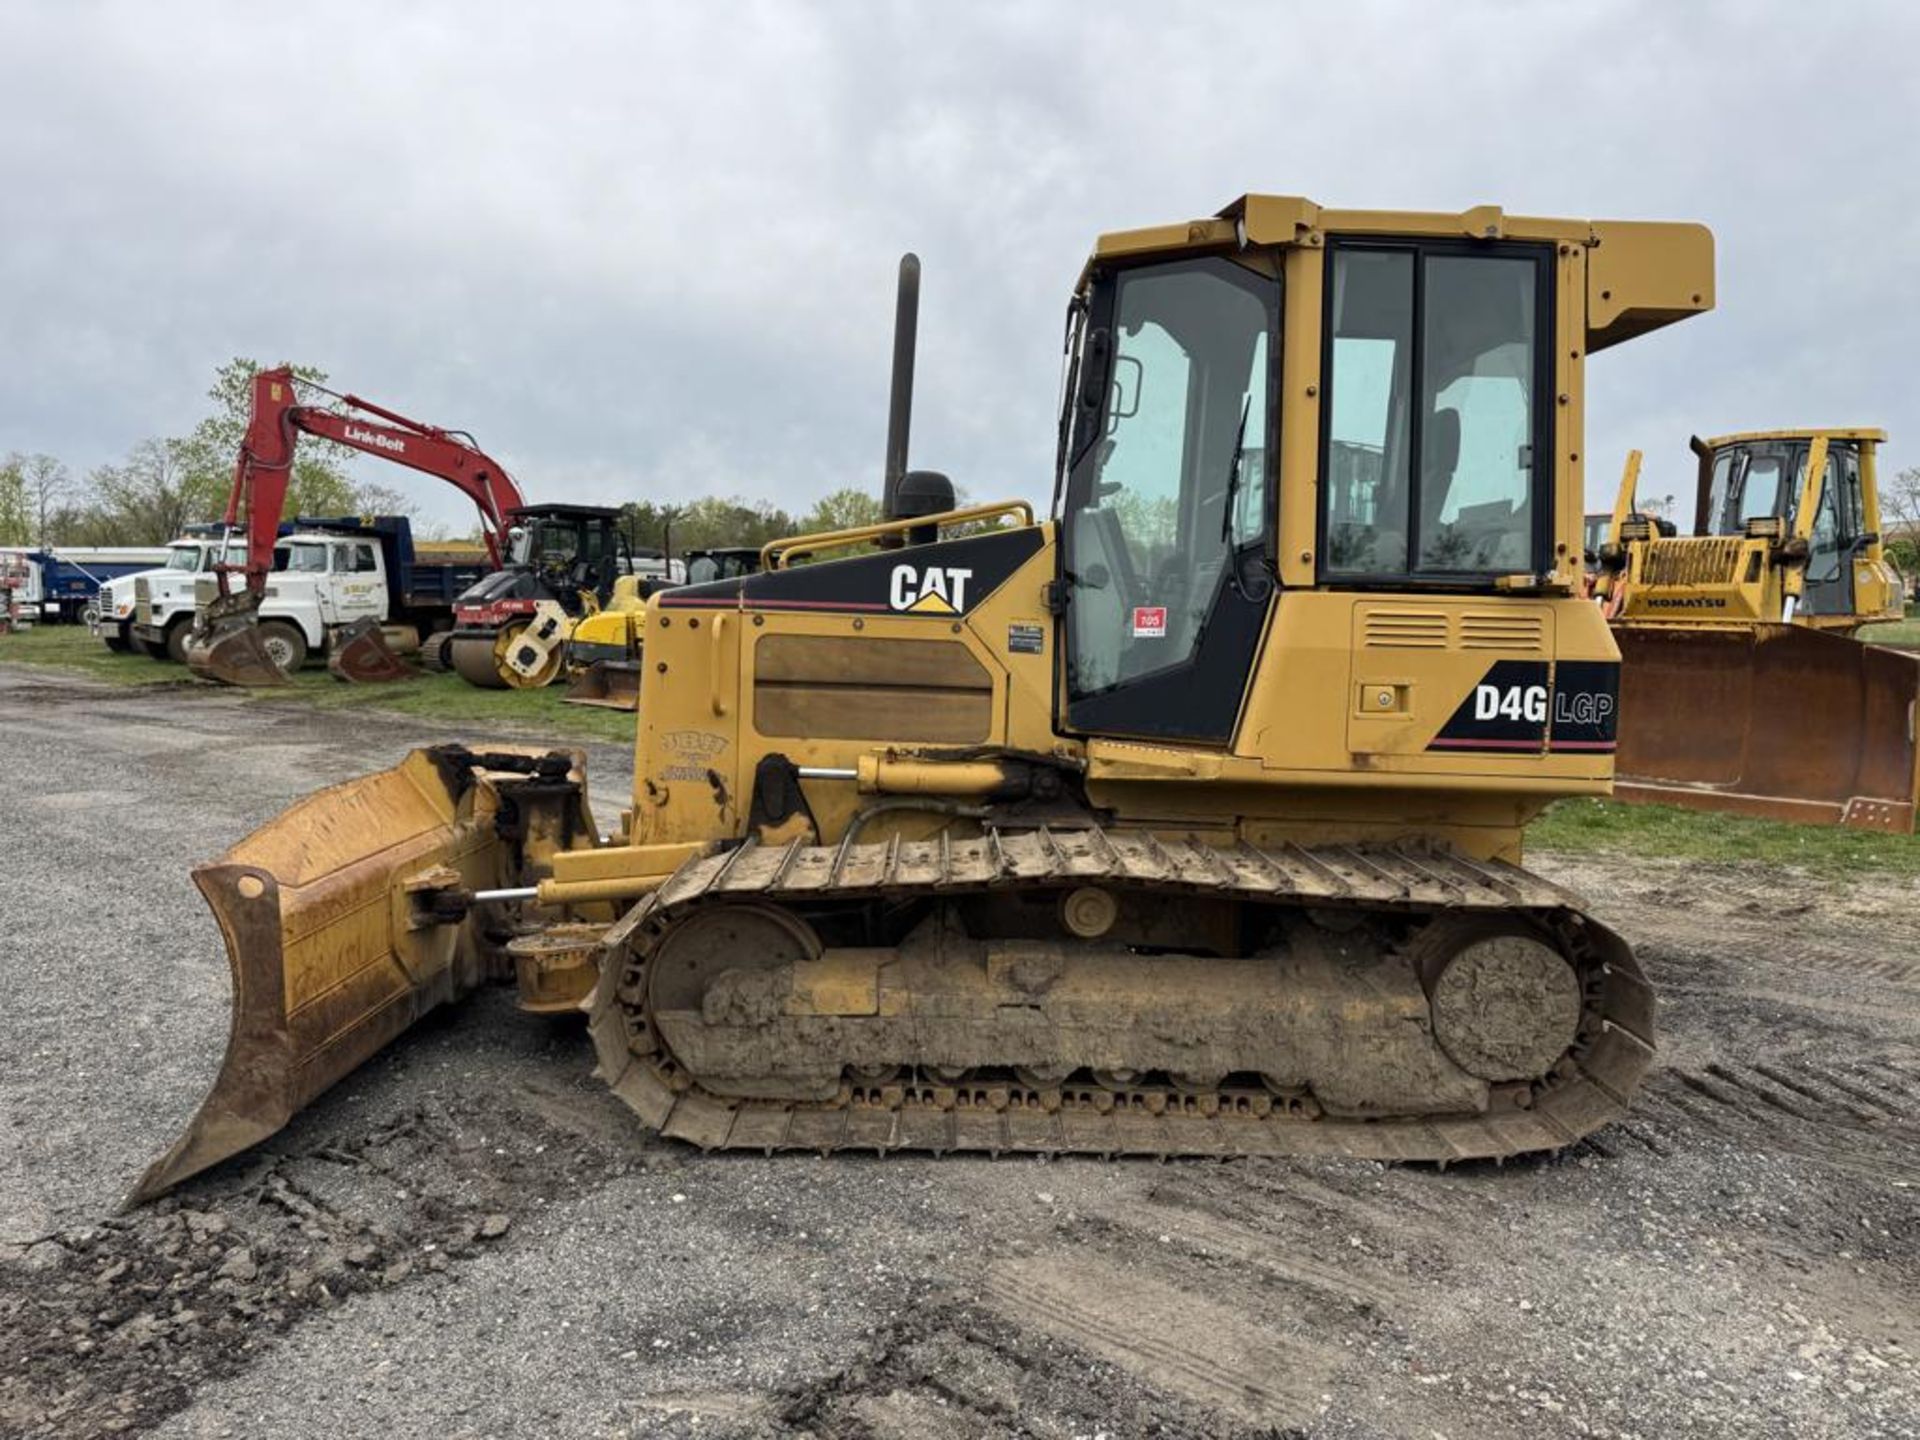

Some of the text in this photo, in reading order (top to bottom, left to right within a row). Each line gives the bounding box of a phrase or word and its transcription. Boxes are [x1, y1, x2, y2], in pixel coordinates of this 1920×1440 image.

[344, 425, 405, 453] Link-Belt
[890, 564, 972, 614] CAT
[1647, 598, 1726, 609] KOMATSU
[1475, 685, 1614, 724] D4G LGP
